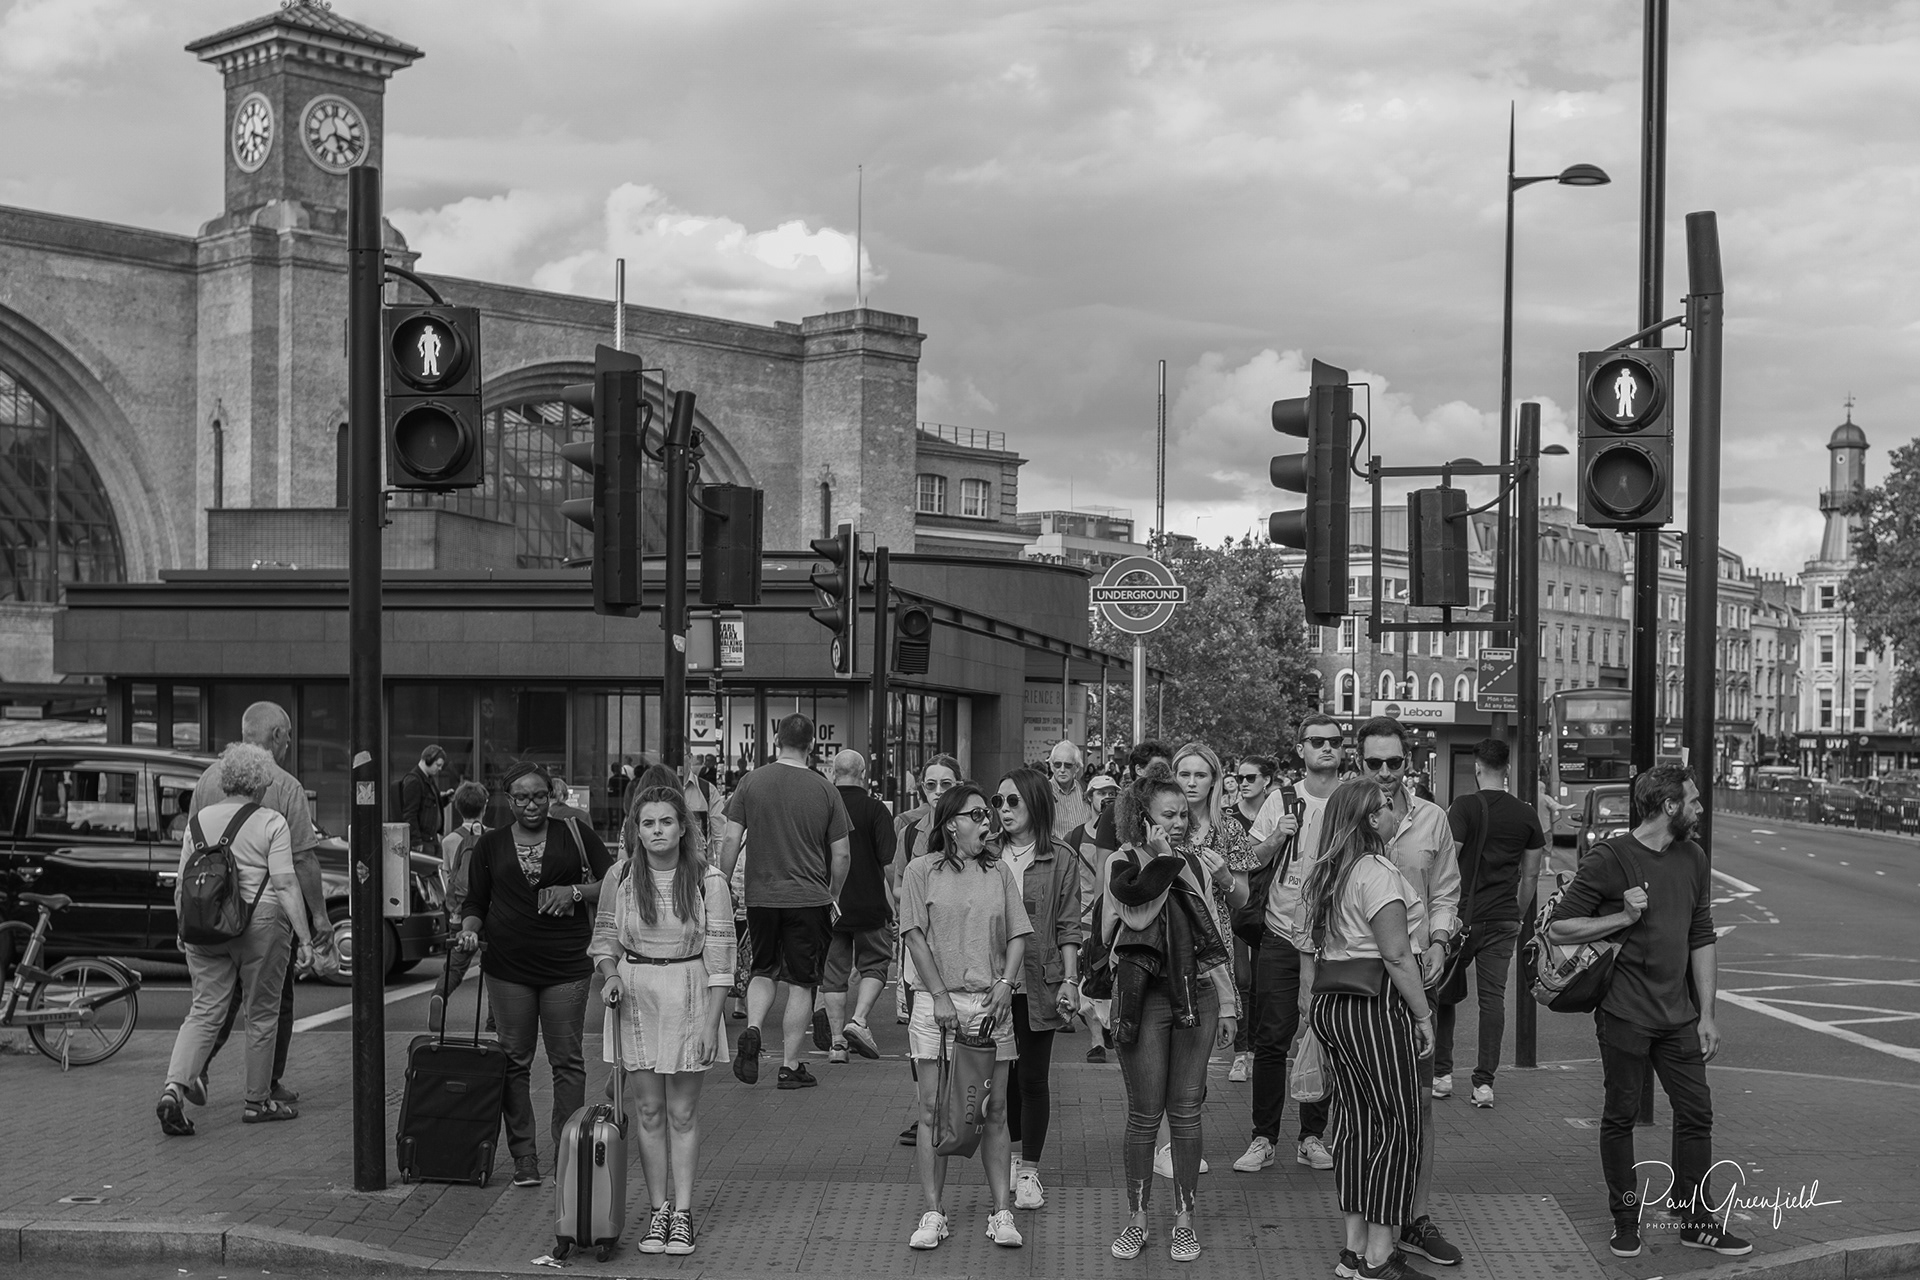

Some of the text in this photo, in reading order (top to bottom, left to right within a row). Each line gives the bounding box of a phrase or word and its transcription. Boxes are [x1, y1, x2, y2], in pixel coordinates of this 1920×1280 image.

[1097, 590, 1180, 600] UNDERGROUND
[1404, 707, 1443, 717] Lebara
[819, 724, 835, 740] OF
[1591, 724, 1605, 735] 63
[966, 1085, 976, 1125] GUCCI
